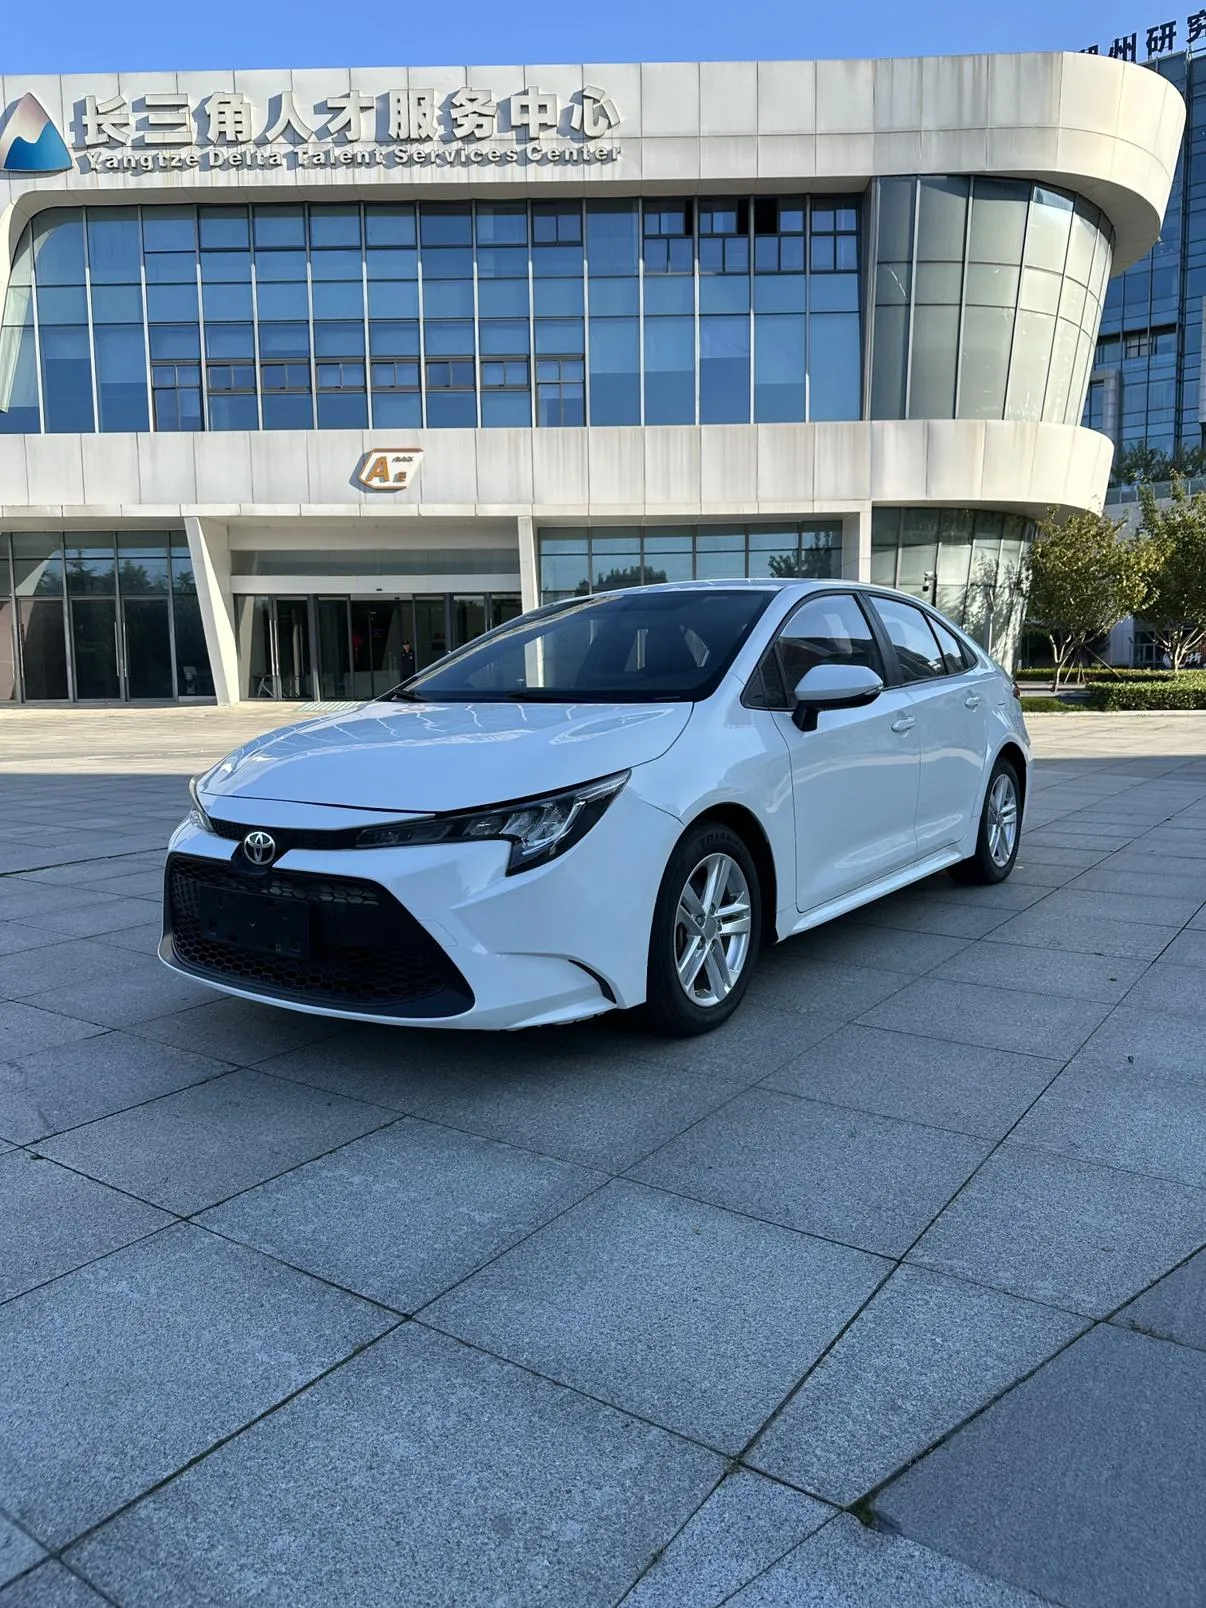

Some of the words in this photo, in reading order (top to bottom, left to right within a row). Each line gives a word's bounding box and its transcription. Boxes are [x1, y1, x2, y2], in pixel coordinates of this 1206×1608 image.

[82, 85, 621, 146] 长三角人才服务中心
[86, 150, 200, 171] Yangtze
[209, 148, 283, 167] Delta
[294, 147, 383, 166] Talent
[394, 146, 518, 164] Services
[526, 145, 622, 162] Center
